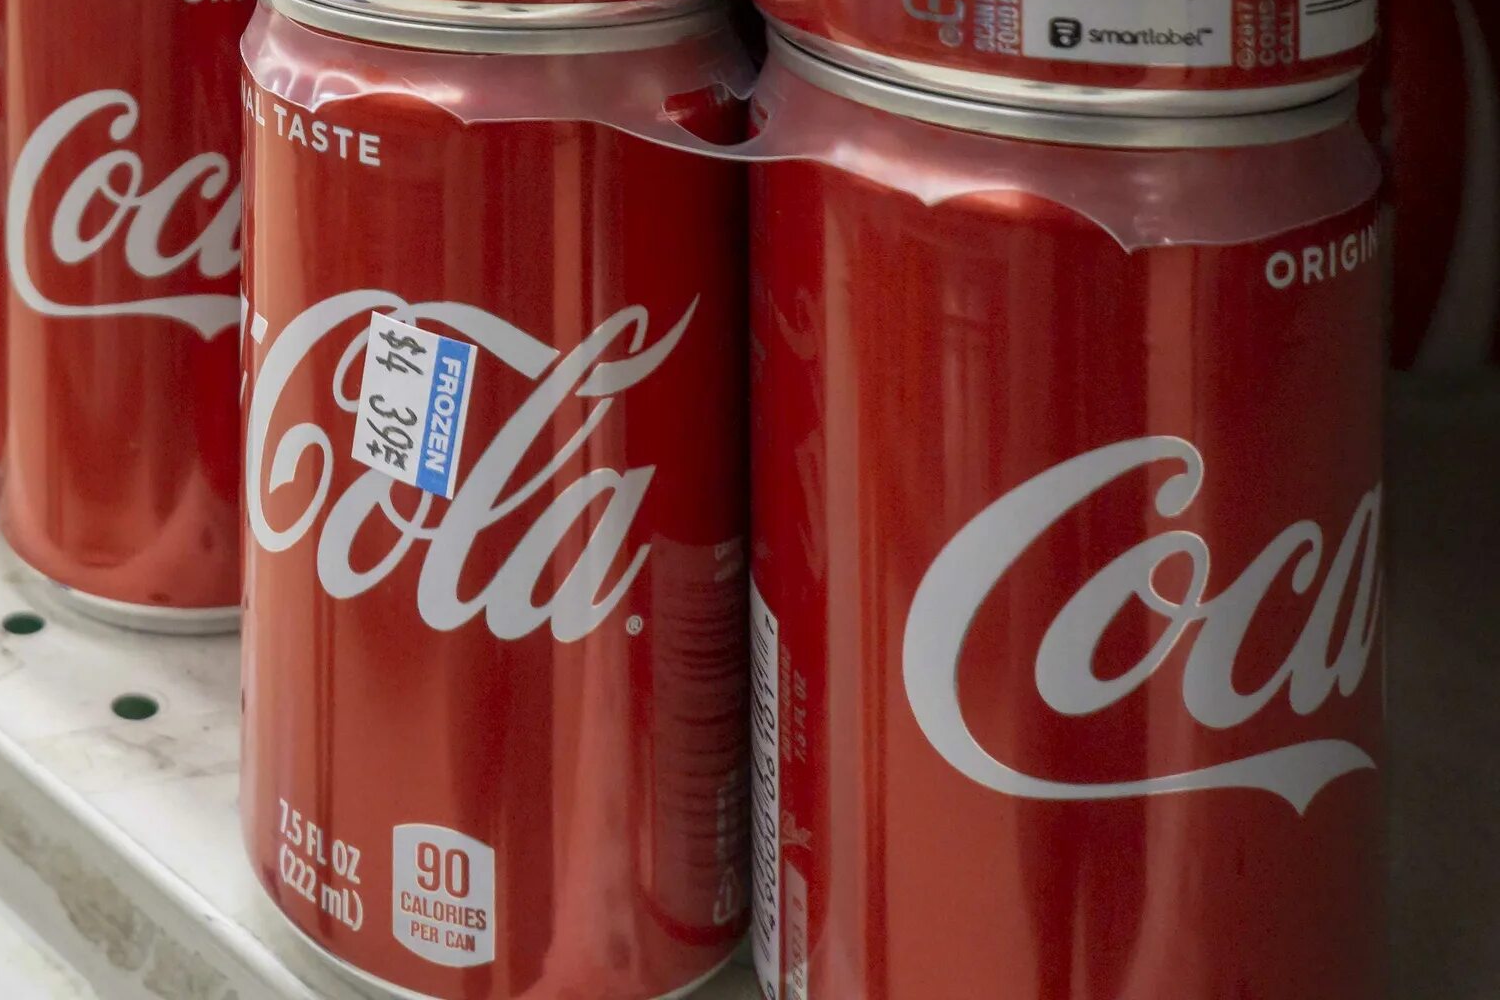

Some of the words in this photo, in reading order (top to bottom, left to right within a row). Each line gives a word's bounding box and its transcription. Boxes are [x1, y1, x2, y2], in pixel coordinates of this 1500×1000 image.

[996, 6, 1020, 56] FOOD
[1088, 26, 1203, 47] smartlabel
[273, 103, 381, 167] TASTE
[424, 355, 463, 475] FROZEN
[279, 797, 302, 846] 7.5
[306, 820, 327, 866] FL
[332, 839, 361, 885] OZ
[416, 841, 470, 900] 90
[279, 843, 317, 904] (222
[321, 883, 363, 932] mL)
[400, 890, 487, 931] CALORIES
[410, 919, 439, 944] PER
[445, 930, 477, 954] CAN
